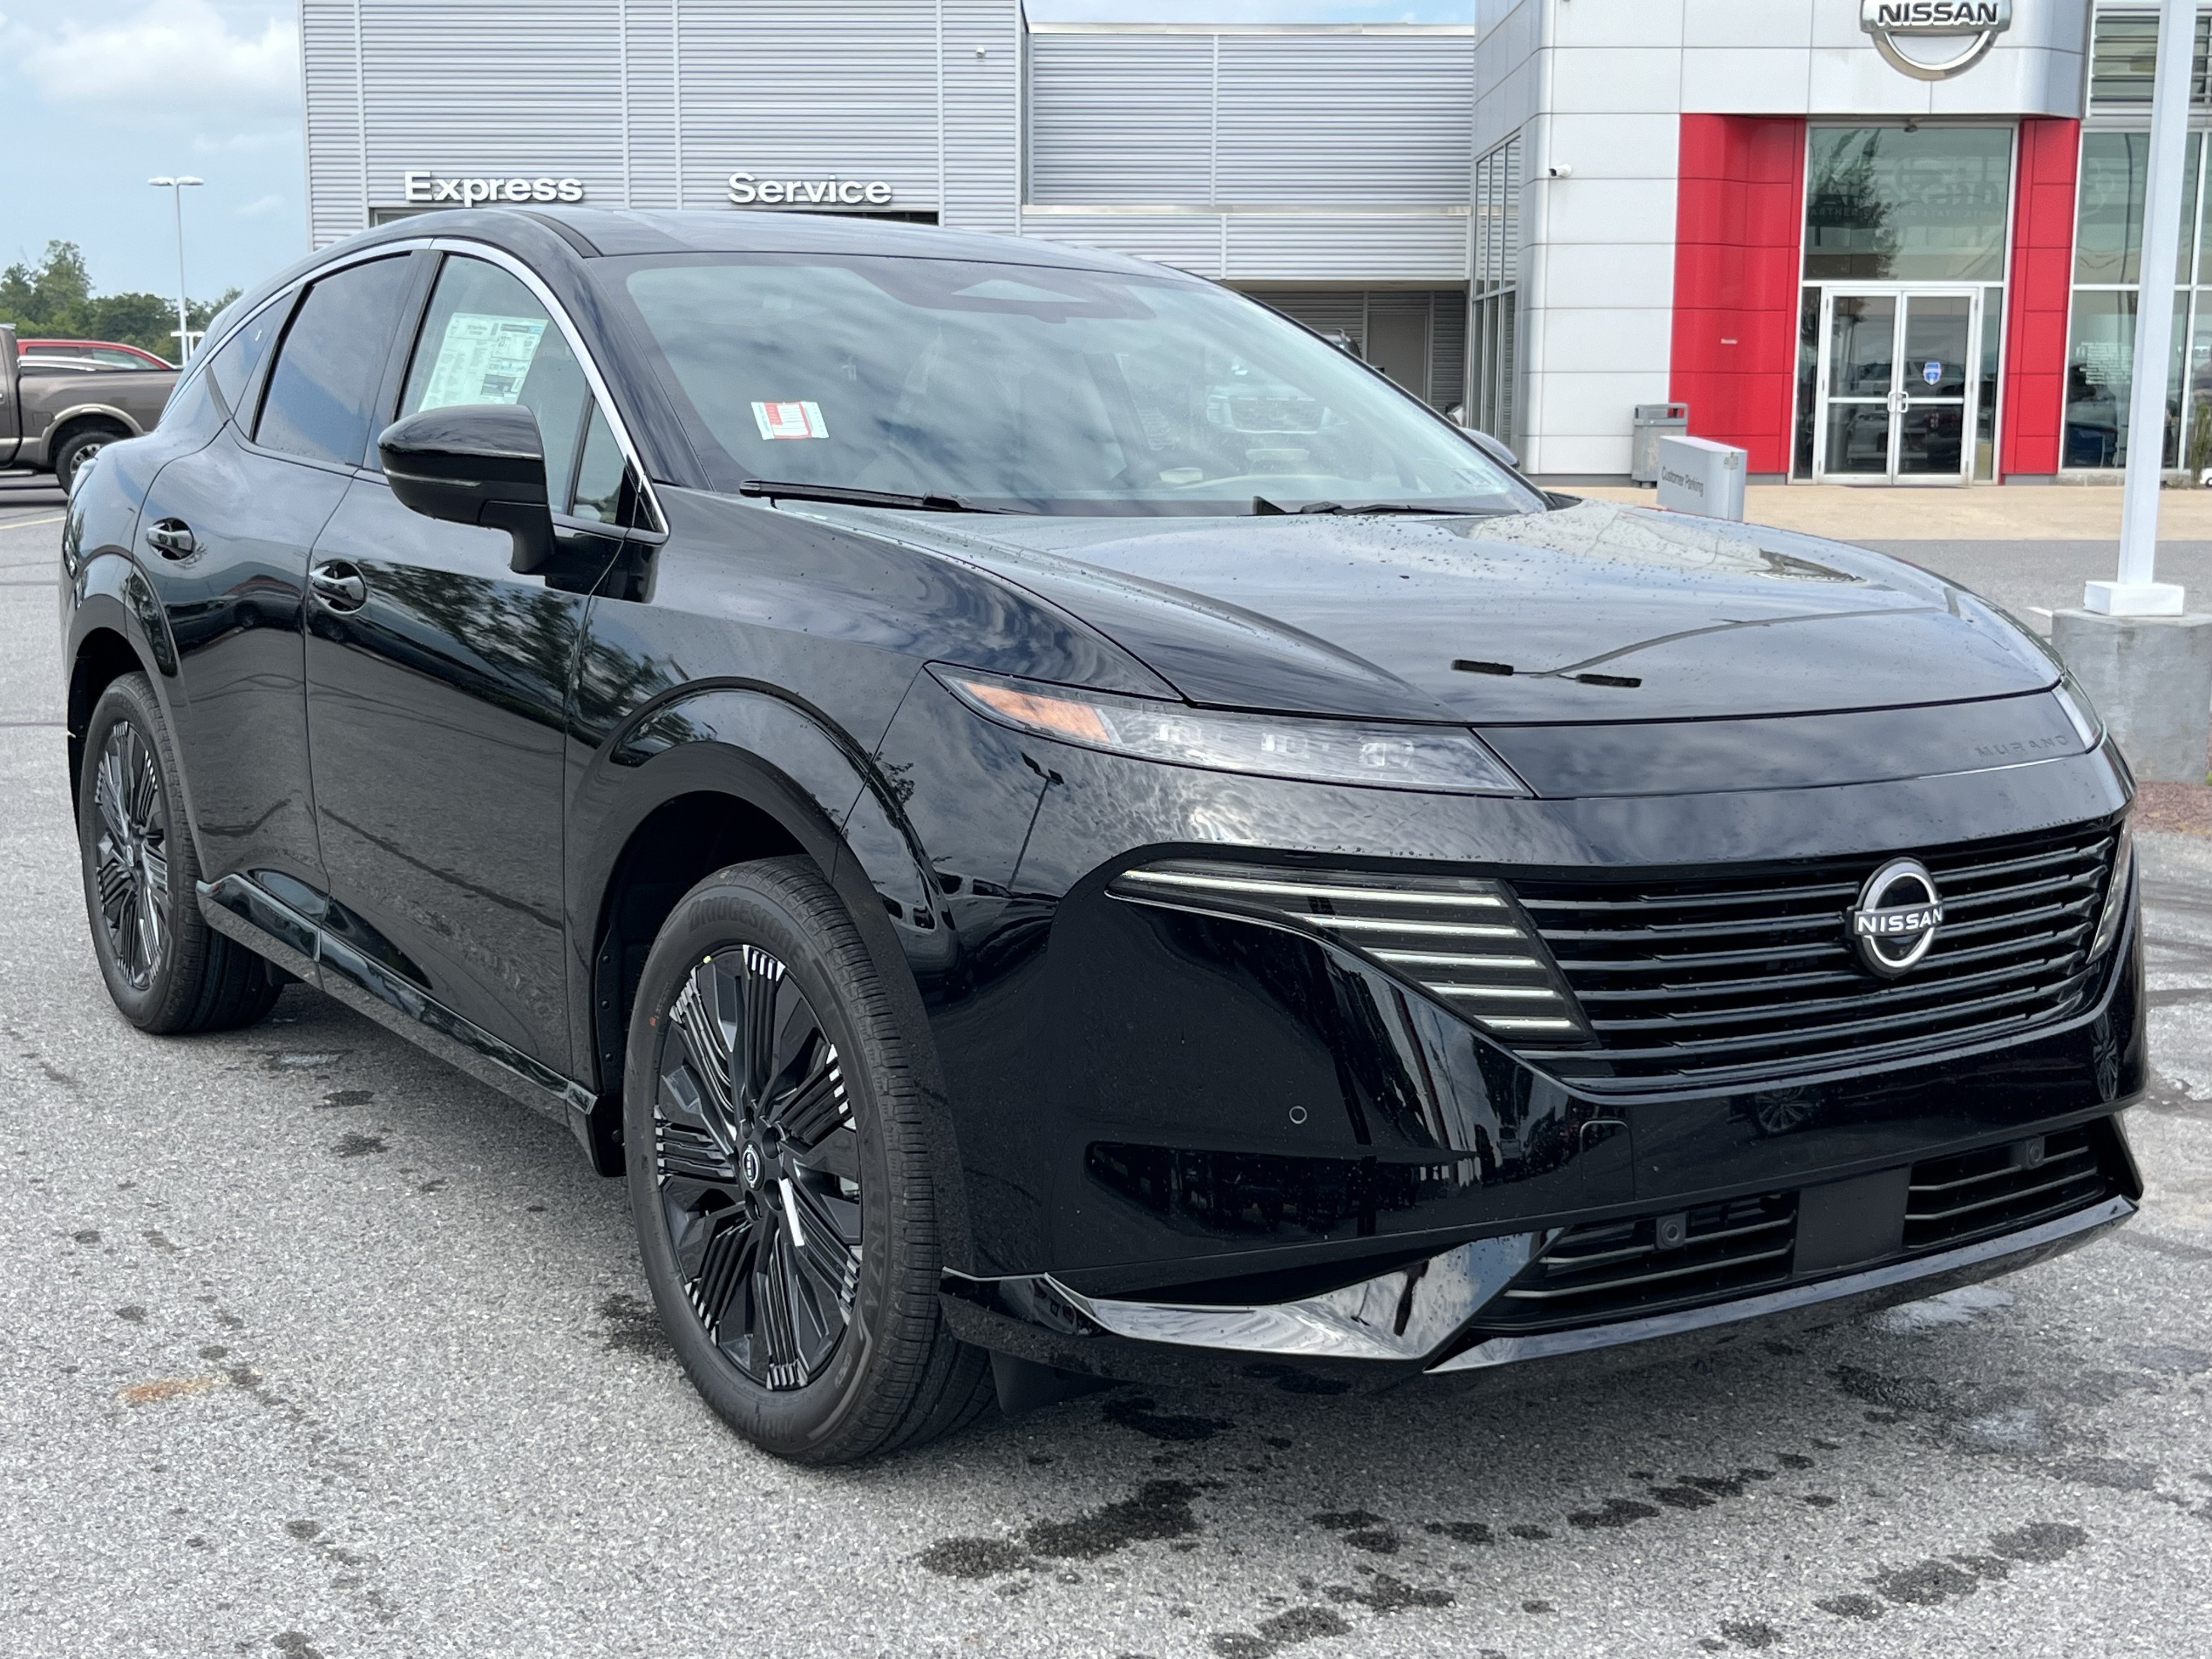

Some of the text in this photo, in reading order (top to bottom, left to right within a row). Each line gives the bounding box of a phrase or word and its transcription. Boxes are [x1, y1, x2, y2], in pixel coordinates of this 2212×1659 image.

[1878, 2, 1998, 24] NISSAN
[405, 171, 892, 207] Express Service
[1662, 466, 1703, 497] Customer Parking
[1974, 735, 2068, 757] MURANO
[1858, 909, 1943, 932] NISSAN
